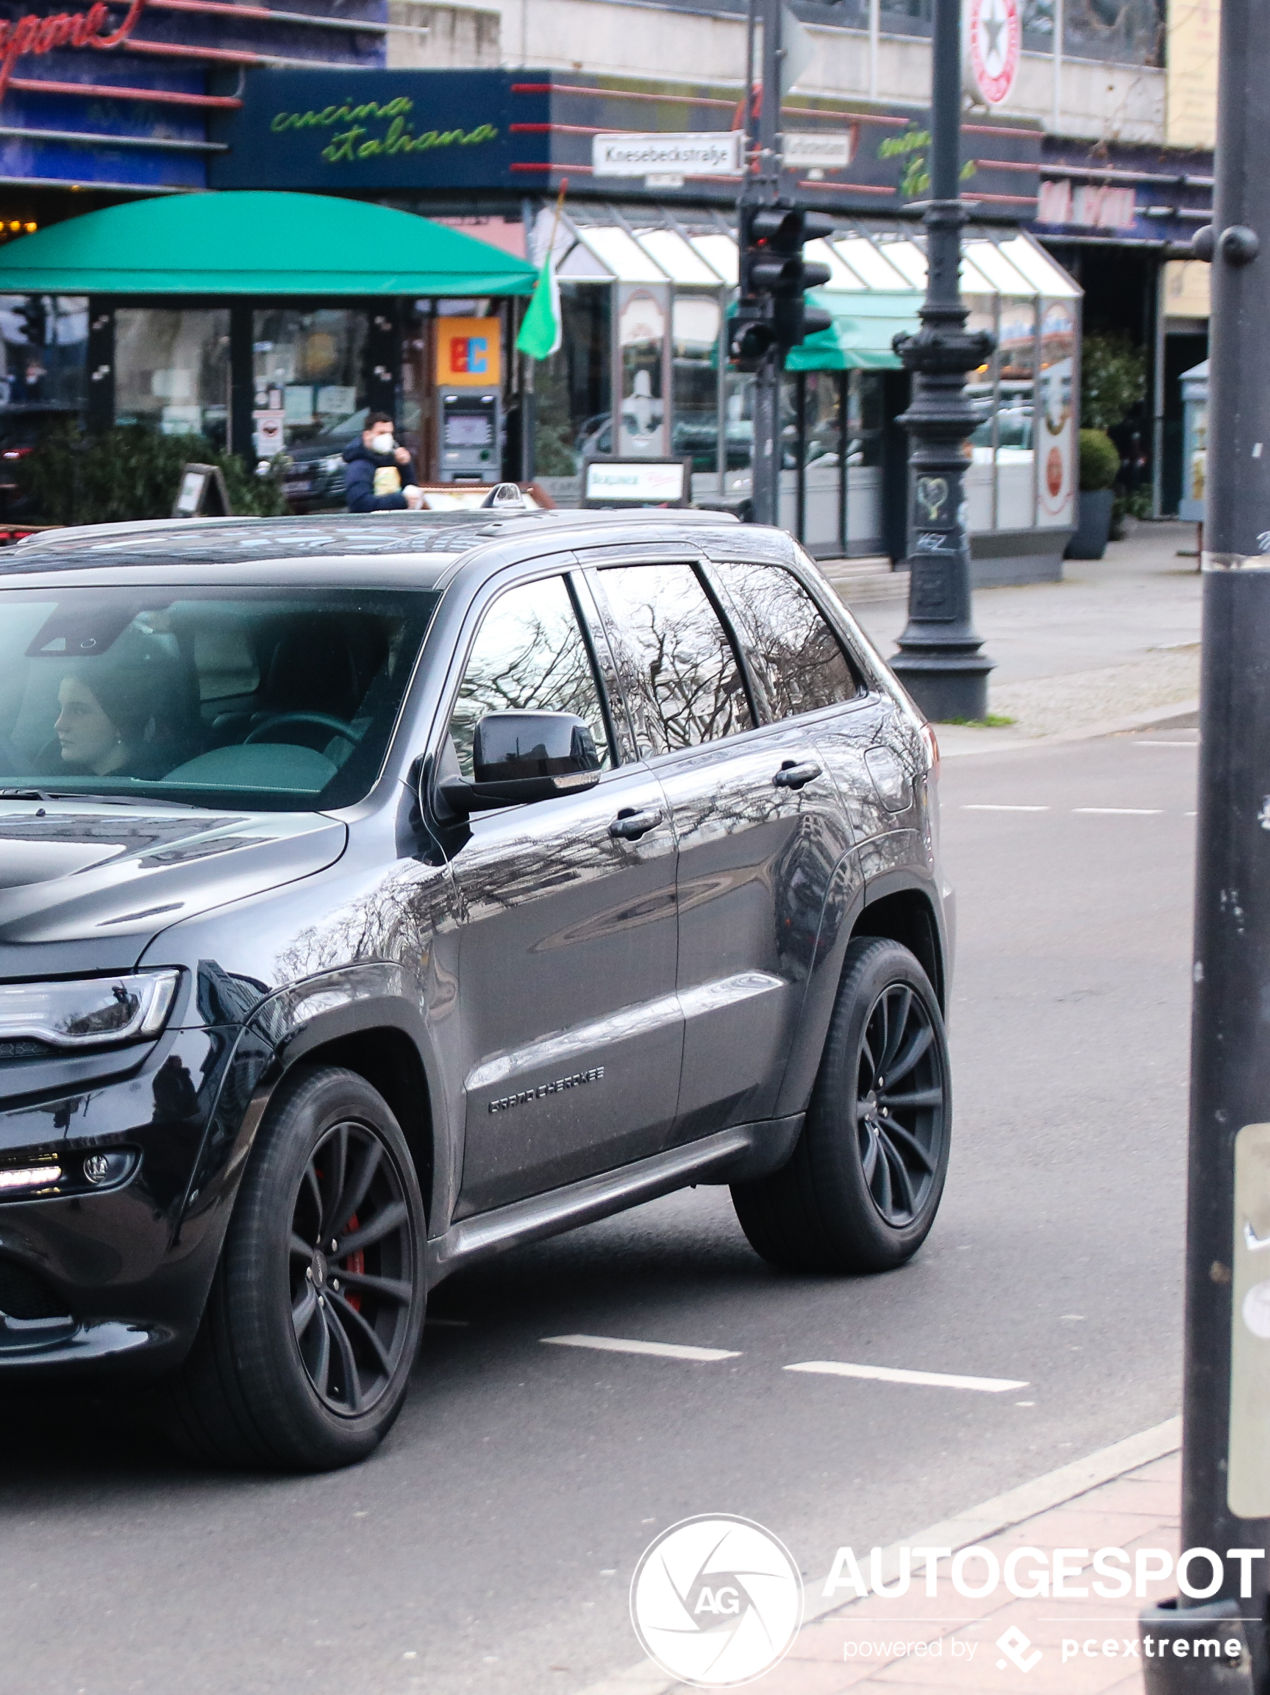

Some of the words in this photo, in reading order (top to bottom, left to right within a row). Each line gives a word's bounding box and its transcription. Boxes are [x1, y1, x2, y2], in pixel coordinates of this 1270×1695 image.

[270, 97, 414, 132] cucina
[322, 116, 499, 162] italiana
[604, 144, 728, 166] Knesebeckstraße
[450, 337, 488, 373] EC
[488, 1089, 534, 1113] GRAND
[535, 1066, 605, 1098] CHEROKEE
